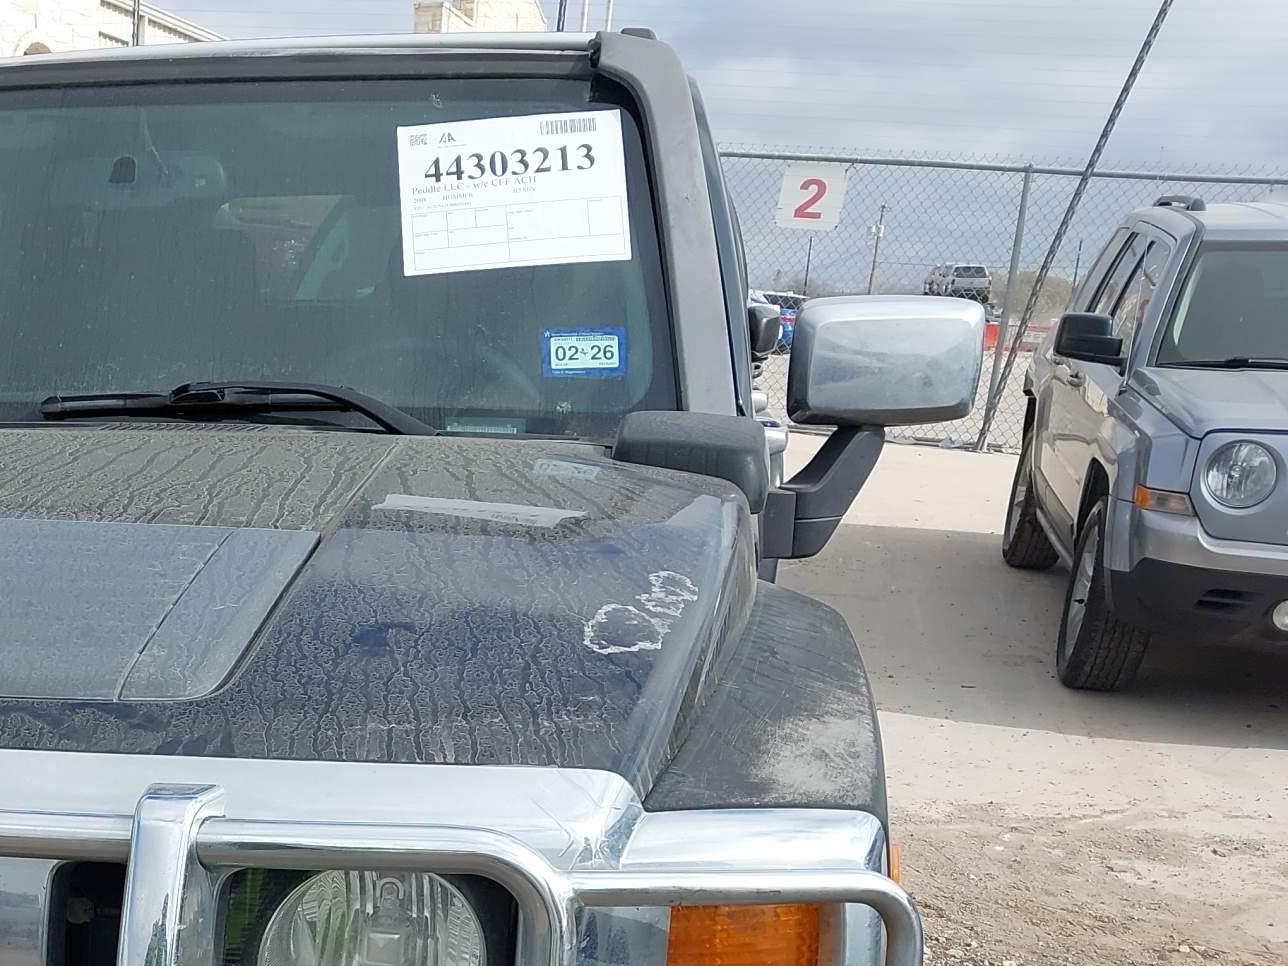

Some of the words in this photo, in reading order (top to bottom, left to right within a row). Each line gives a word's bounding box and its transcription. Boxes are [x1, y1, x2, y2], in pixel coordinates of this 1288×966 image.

[424, 143, 596, 183] 44303213
[412, 185, 441, 195] Peddle
[443, 182, 464, 192] LLC
[514, 175, 537, 185] ACH
[793, 178, 827, 219] 2
[555, 345, 579, 361] 02
[590, 344, 615, 360] 26
